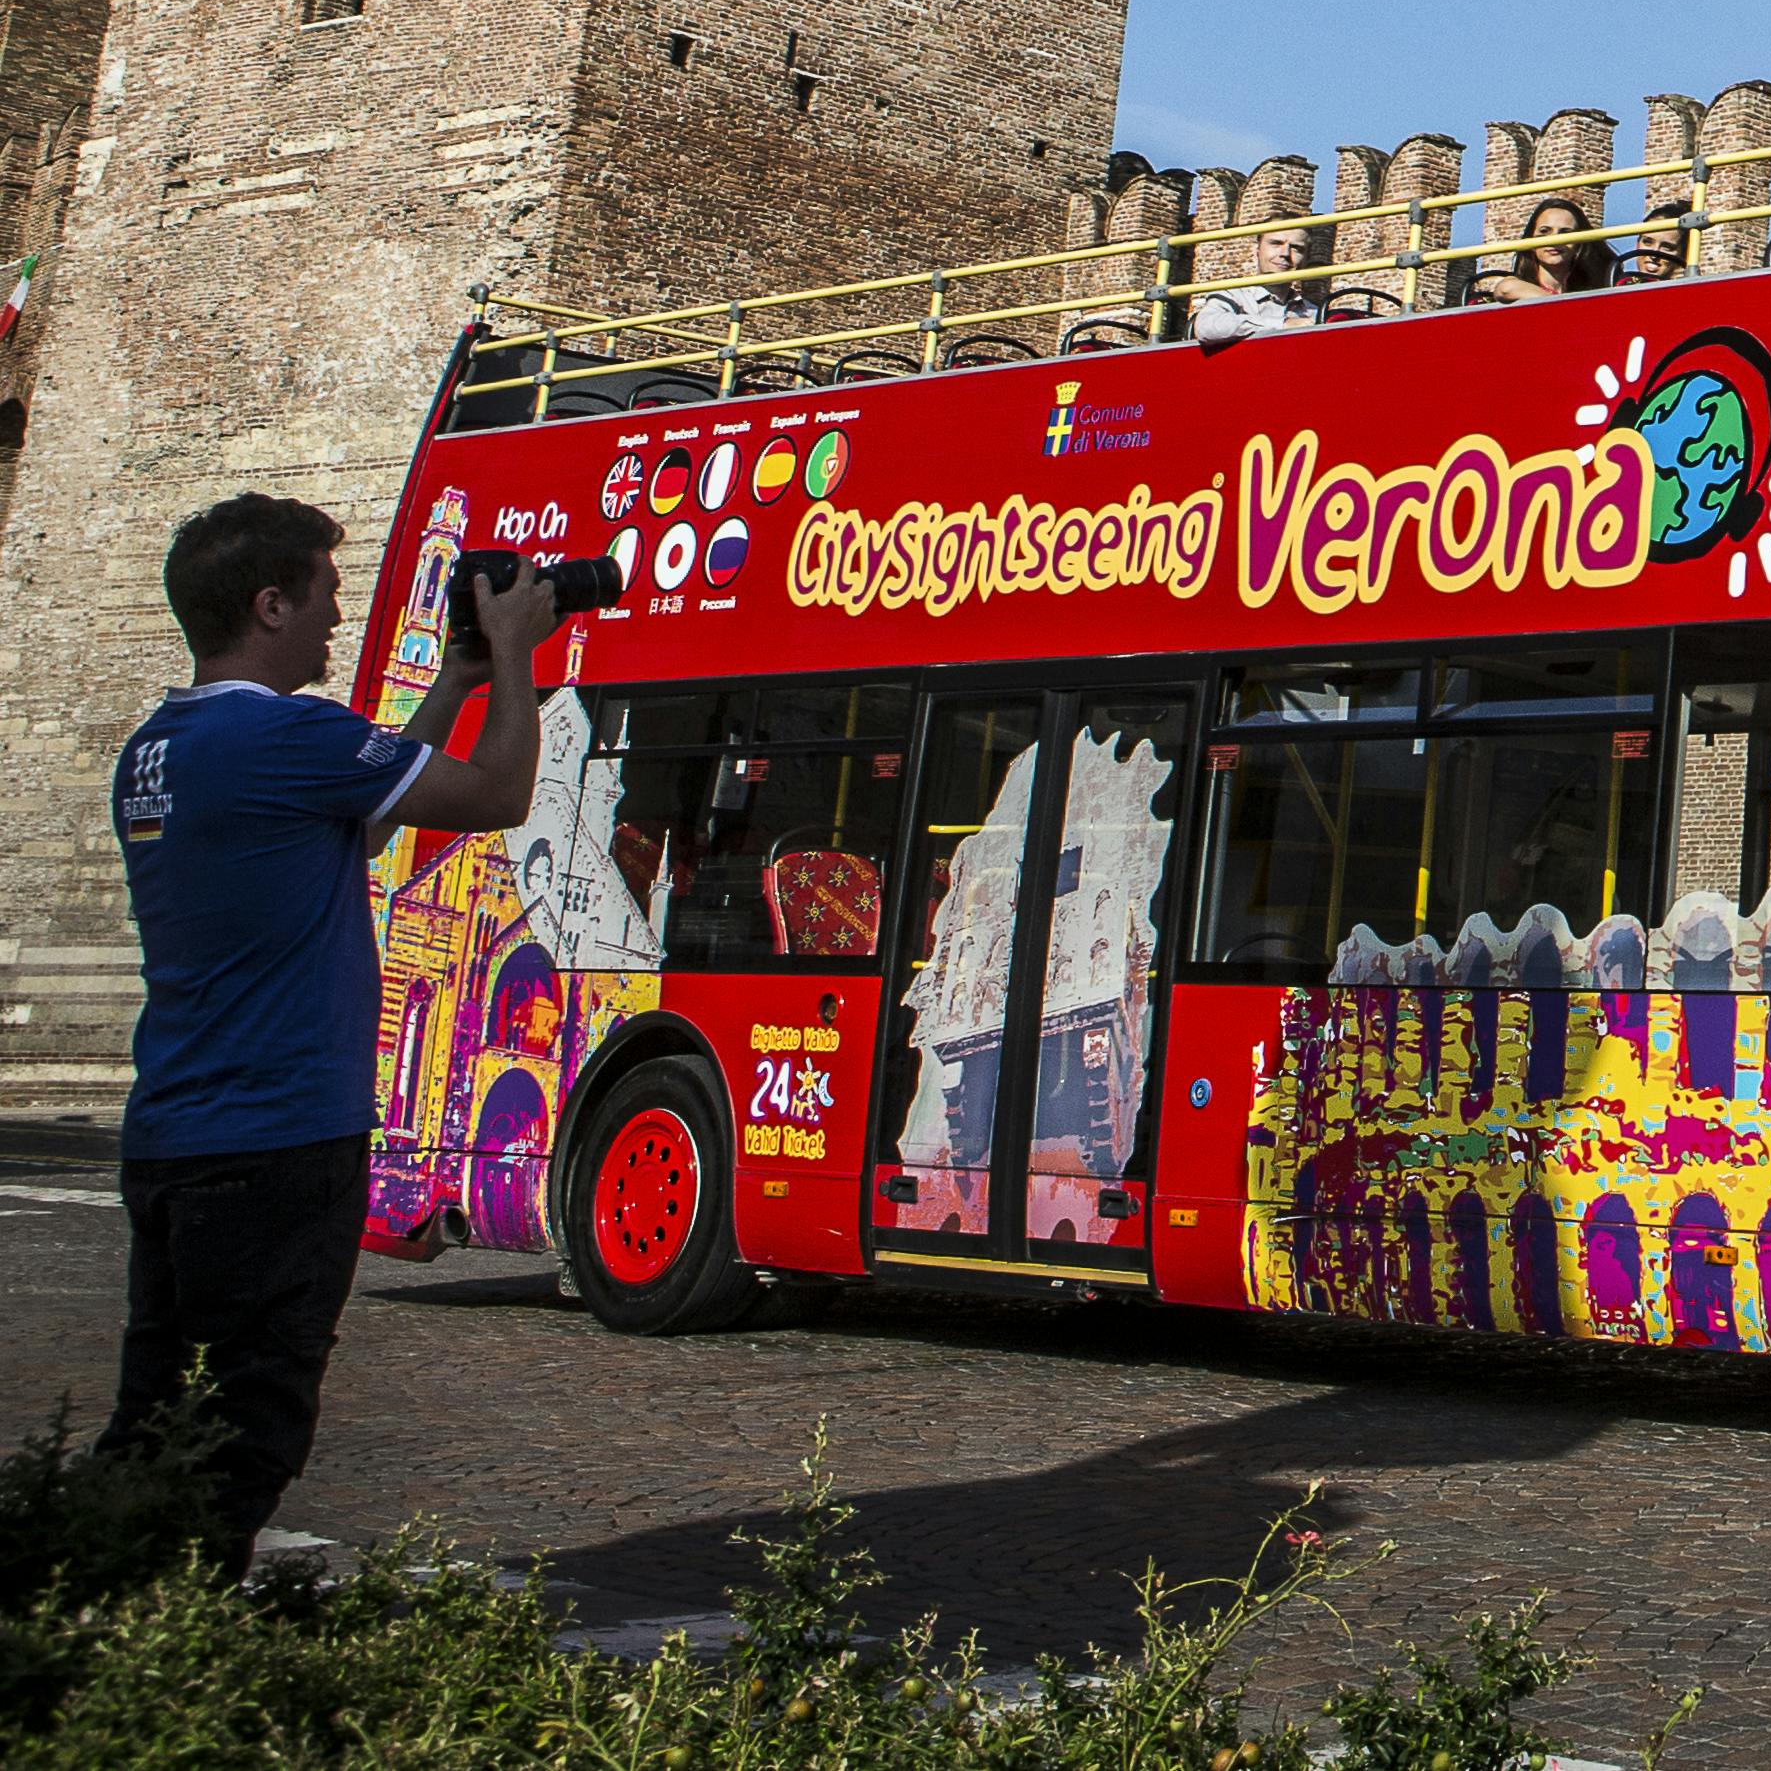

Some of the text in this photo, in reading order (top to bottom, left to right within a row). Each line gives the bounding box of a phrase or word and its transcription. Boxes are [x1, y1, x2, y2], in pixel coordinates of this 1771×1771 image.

[1079, 404, 1144, 424] Comune
[663, 427, 700, 442] Deutsch
[1073, 430, 1151, 453] di Verona
[493, 501, 569, 546] Hop On
[1239, 429, 1656, 614] Verona
[649, 594, 684, 616] 日本語
[123, 794, 173, 818] BERLIN
[751, 1023, 840, 1053] Biglietto Valido
[751, 1059, 790, 1118] 24
[745, 1124, 826, 1160] Valid Ticket
